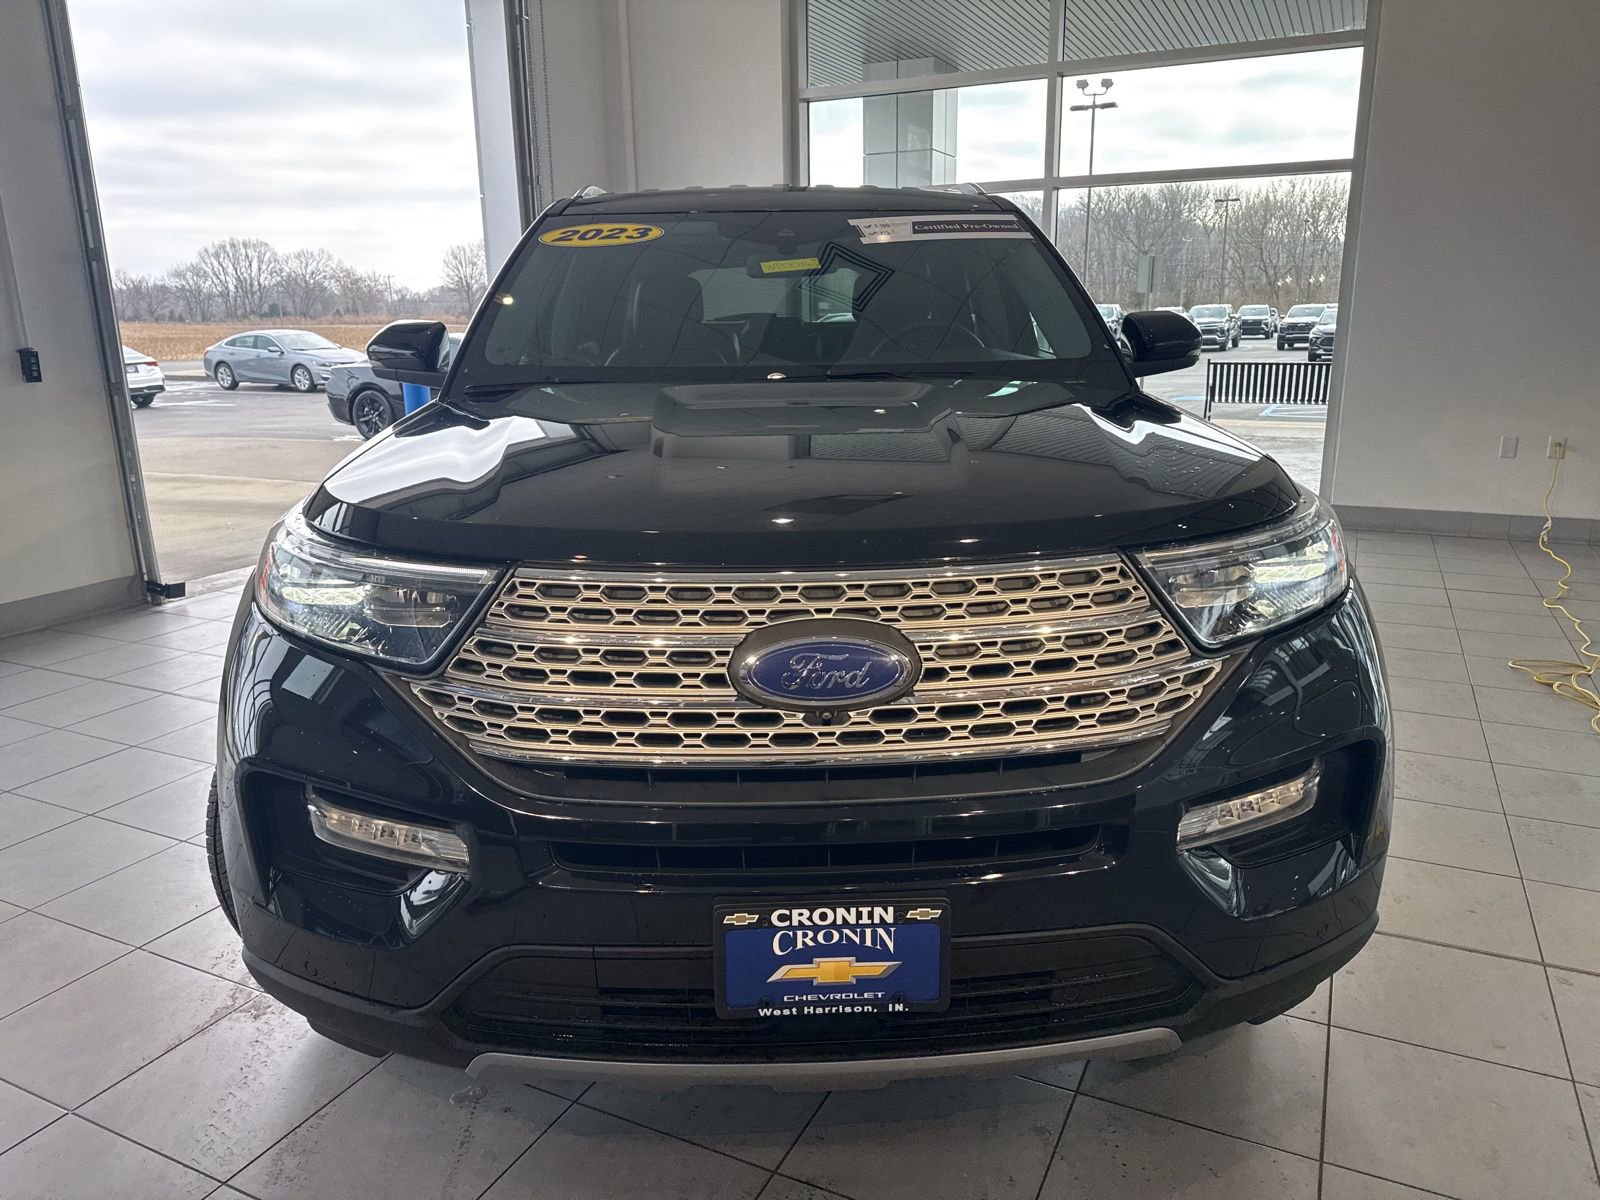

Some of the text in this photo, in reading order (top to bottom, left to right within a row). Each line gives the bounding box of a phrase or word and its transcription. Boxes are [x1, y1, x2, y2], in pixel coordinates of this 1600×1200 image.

[914, 222, 960, 231] Certified
[962, 222, 1019, 230] Pre-Owned
[550, 227, 654, 242] 2023
[780, 652, 873, 690] Ford
[770, 906, 895, 927] CRONIN
[772, 927, 897, 956] CRONIN
[783, 991, 886, 1002] CHEVROLET
[758, 1003, 910, 1017] West Harrison, IN.
